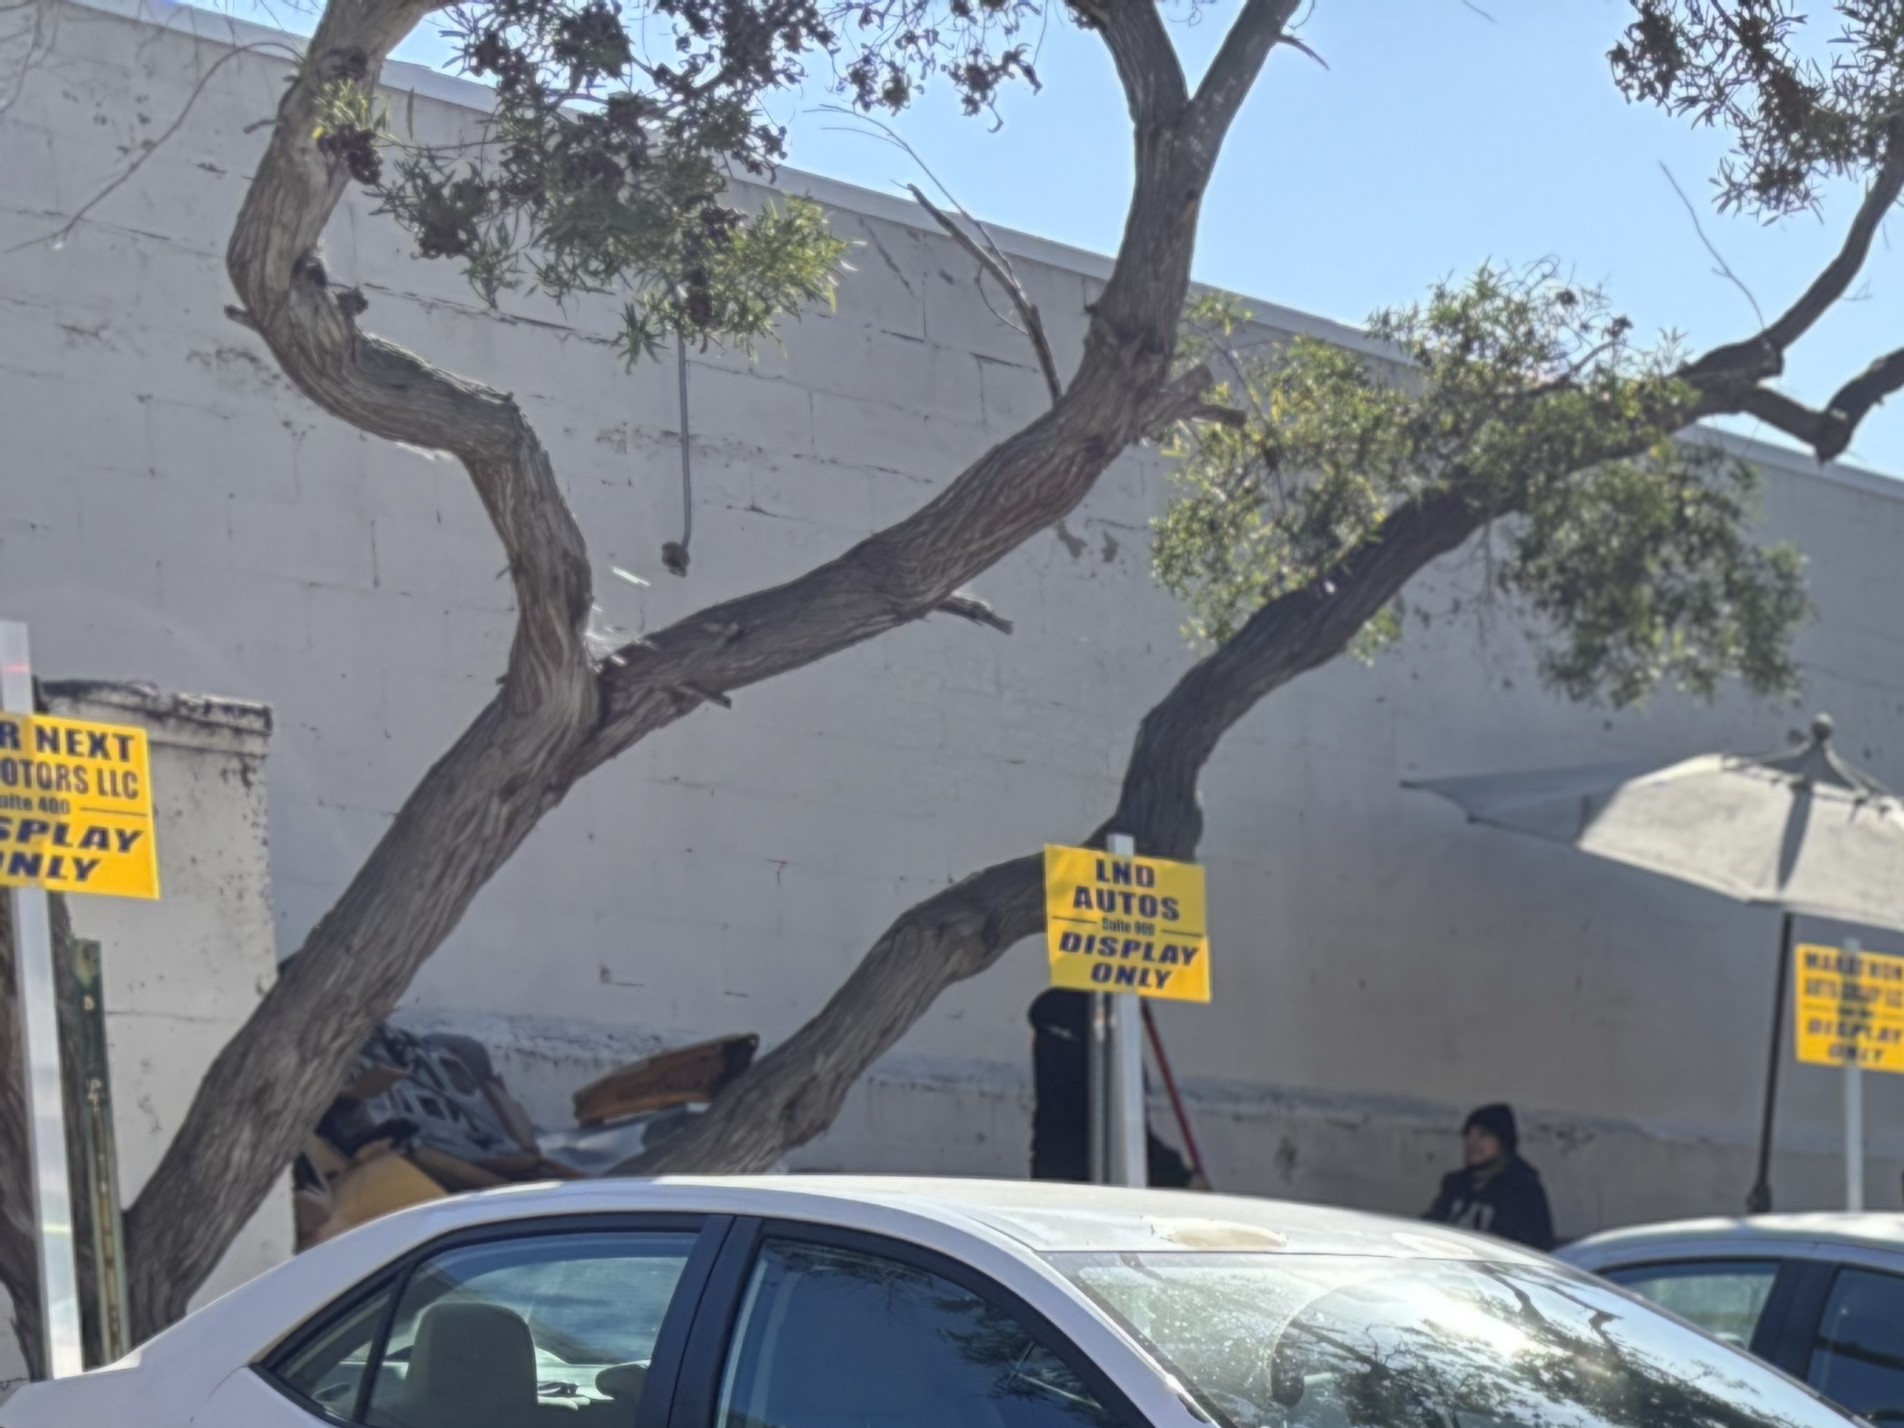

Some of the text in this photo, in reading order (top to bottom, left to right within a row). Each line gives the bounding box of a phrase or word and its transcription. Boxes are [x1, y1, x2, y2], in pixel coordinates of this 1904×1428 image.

[35, 725, 135, 763] NEXT
[0, 757, 139, 800] OTORS LLC
[0, 851, 102, 882] NLY
[1096, 858, 1155, 888] LND
[1073, 886, 1180, 921] AUTOS
[1059, 932, 1199, 966] DISPLAY
[1091, 963, 1172, 989] ONLY
